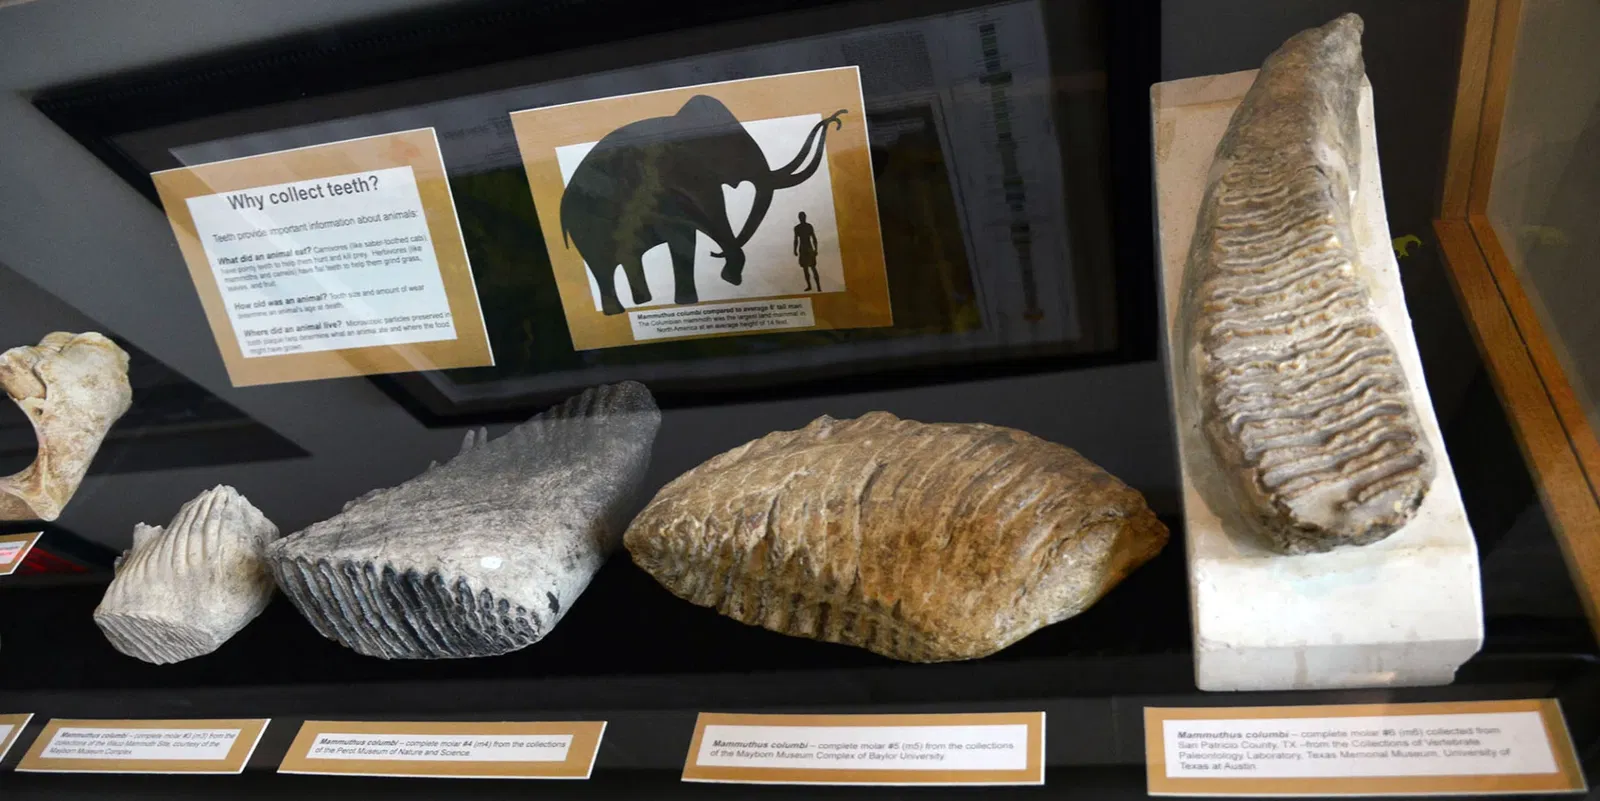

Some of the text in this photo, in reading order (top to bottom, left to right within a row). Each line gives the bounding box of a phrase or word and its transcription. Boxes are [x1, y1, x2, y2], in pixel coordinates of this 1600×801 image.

[227, 175, 378, 210] Why collect teeth?
[212, 233, 236, 242] Teeth
[308, 218, 355, 230] information
[358, 214, 381, 224] about
[240, 255, 252, 263] did
[266, 249, 292, 259] animal
[313, 244, 348, 254] Carnivores
[384, 257, 400, 266] grind
[234, 302, 251, 310] How
[296, 322, 321, 332] animal
[412, 312, 444, 320] preserved
[1300, 730, 1347, 738] complete
[712, 740, 768, 749] Mammuthus
[901, 742, 923, 750] (m5)
[1200, 741, 1238, 749] Patricio
[1332, 740, 1348, 748] the
[1351, 739, 1409, 747] Collections
[1412, 739, 1422, 747] of
[1424, 738, 1481, 746] Vertebrate
[736, 751, 774, 759] Mayborn
[776, 751, 813, 759] Museum
[816, 751, 854, 760] Complex
[869, 752, 897, 760] Baylor
[1179, 751, 1243, 761] Paleontology
[1443, 749, 1497, 758] University
[1499, 748, 1511, 756] of
[1180, 762, 1209, 770] Texas
[1212, 762, 1222, 770] at
